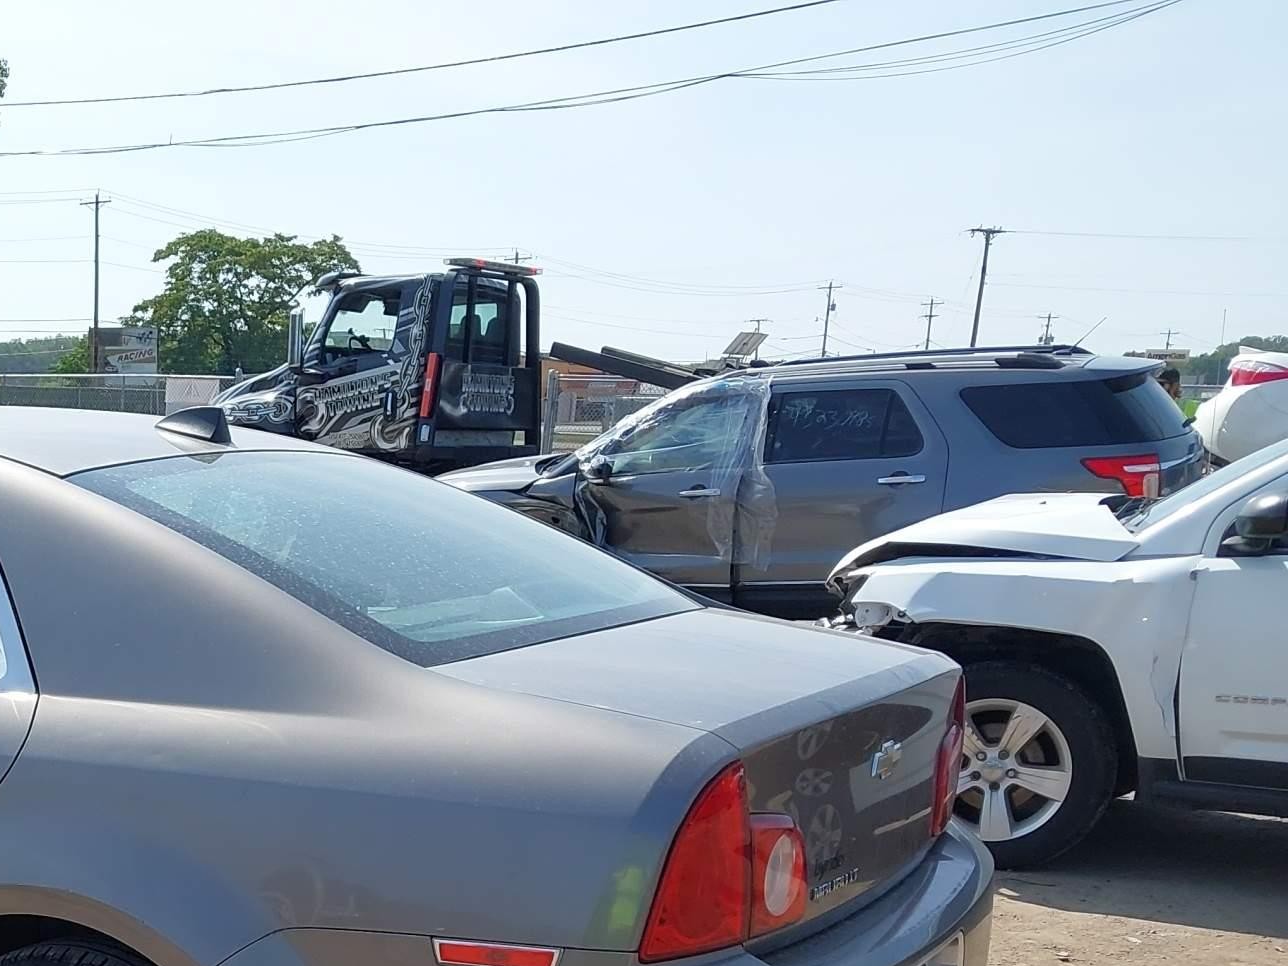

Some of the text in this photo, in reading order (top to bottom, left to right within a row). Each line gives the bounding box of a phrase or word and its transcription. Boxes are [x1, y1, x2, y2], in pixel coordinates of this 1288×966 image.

[117, 348, 153, 362] RACING
[327, 390, 381, 417] TOWING
[1215, 695, 1288, 706] COMP
